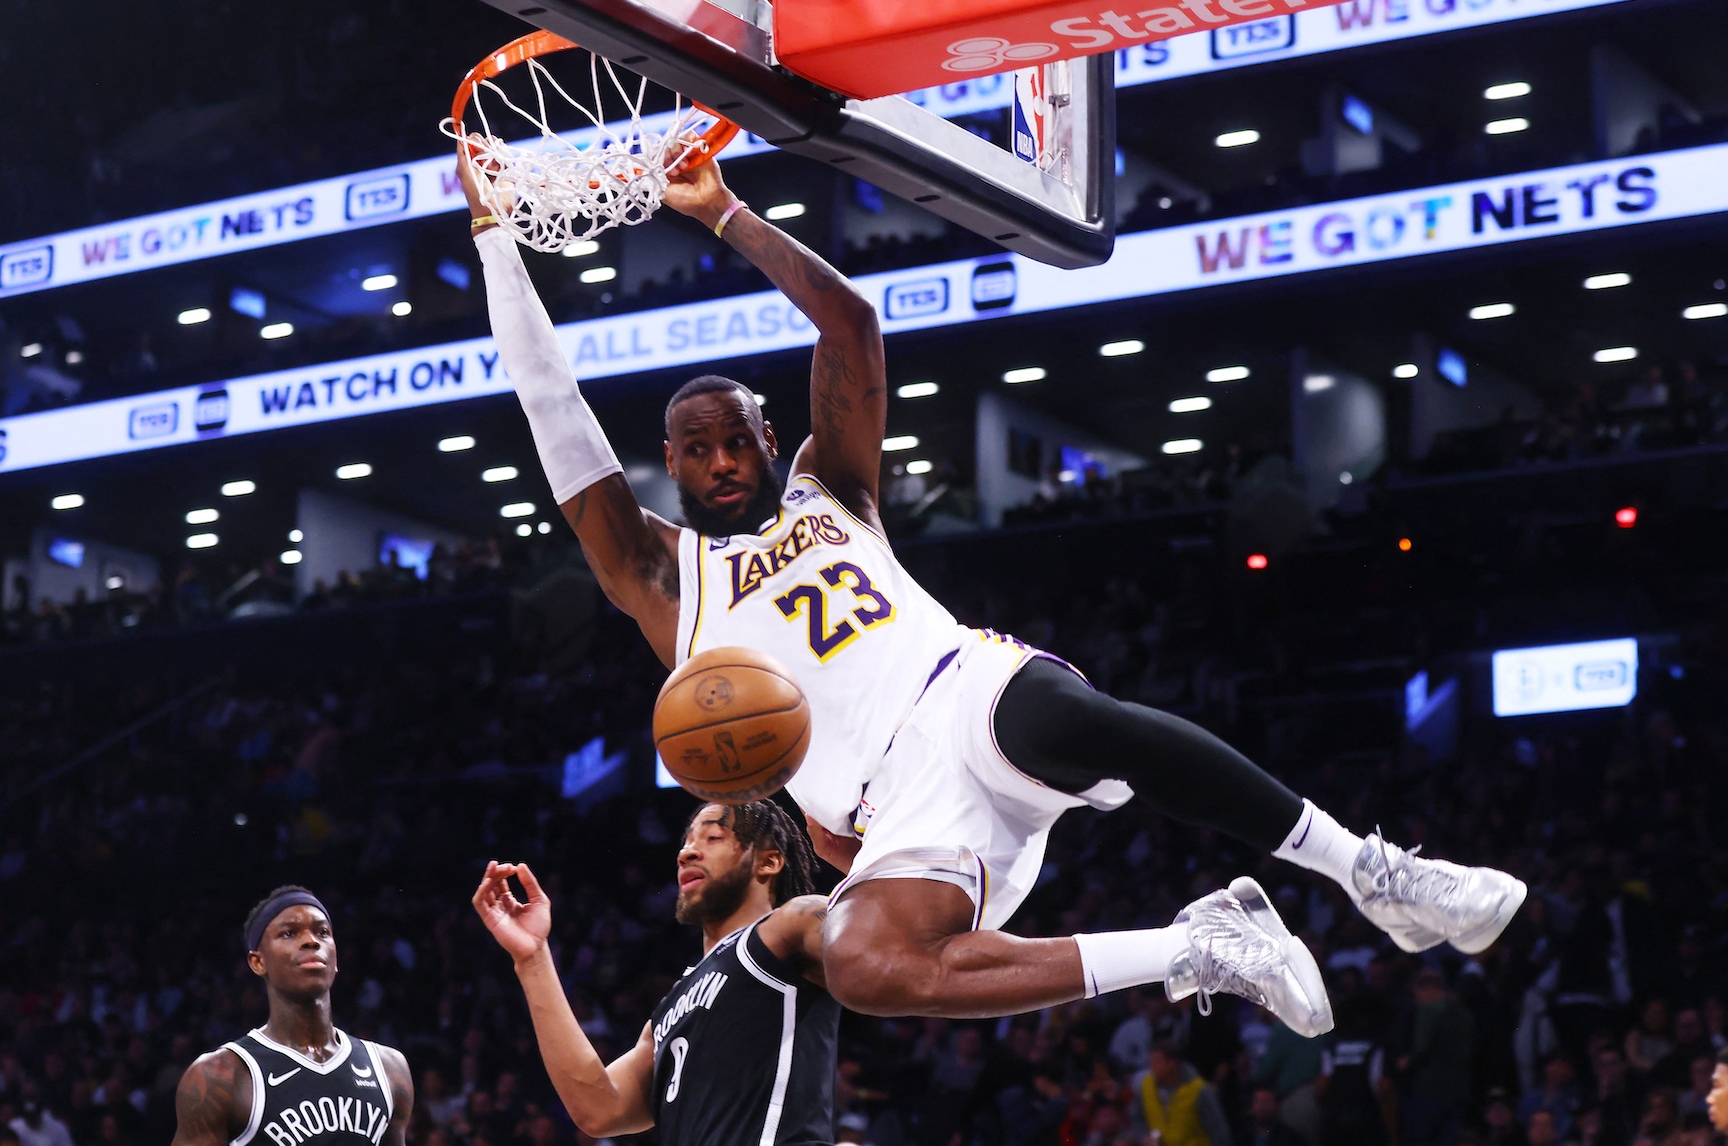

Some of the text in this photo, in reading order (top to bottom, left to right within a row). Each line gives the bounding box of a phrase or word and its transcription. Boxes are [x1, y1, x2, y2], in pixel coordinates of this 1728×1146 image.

[1017, 131, 1034, 158] NBA
[82, 197, 315, 266] WE GOT NETS
[1195, 167, 1657, 274] WE GOT NETS
[575, 304, 813, 367] ALL SEASO
[260, 366, 397, 414] WATCH
[410, 356, 464, 392] ON
[725, 513, 851, 614] LAKERS
[771, 559, 897, 665] 23
[653, 970, 729, 1053] ROOKLYN
[264, 1096, 389, 1146] BROOKLYN
